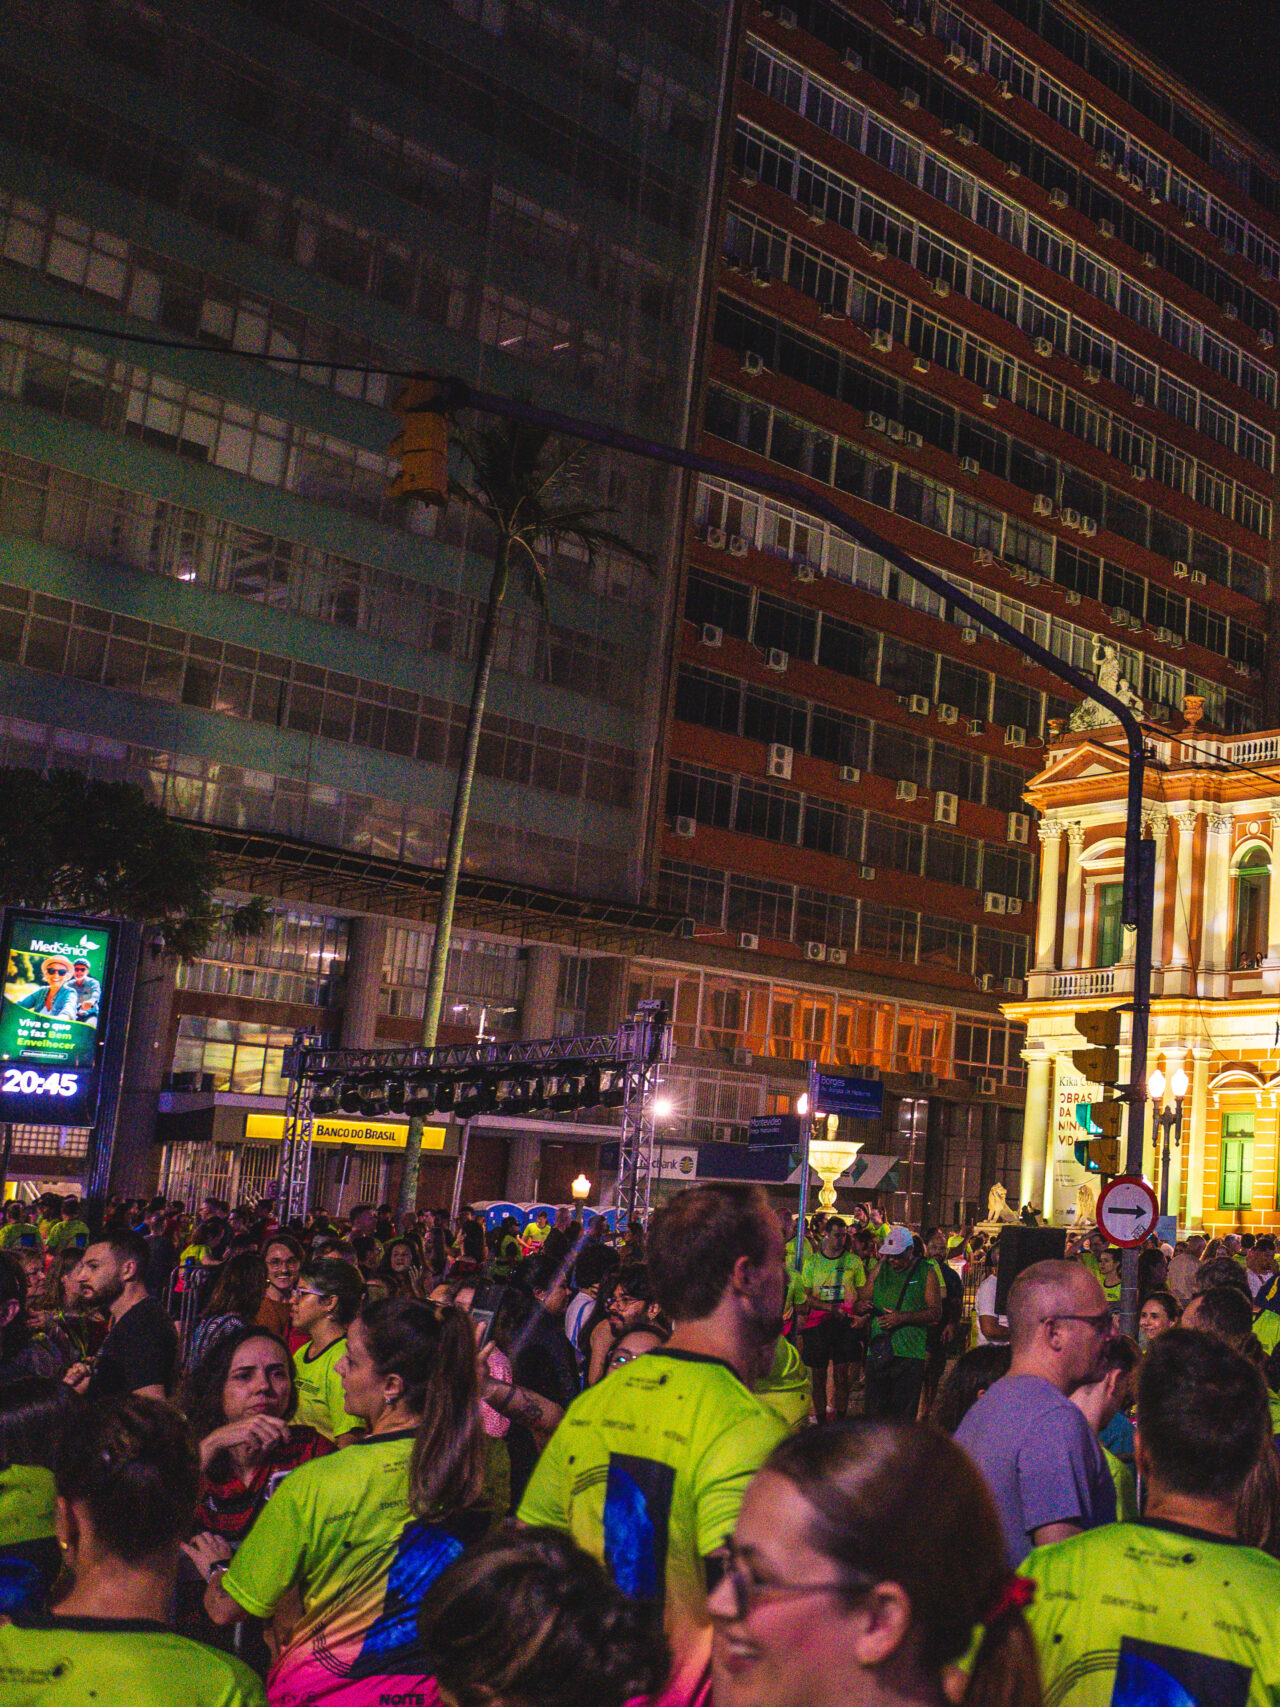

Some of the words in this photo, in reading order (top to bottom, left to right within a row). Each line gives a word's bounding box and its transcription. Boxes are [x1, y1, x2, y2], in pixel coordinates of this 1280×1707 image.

[30, 939, 89, 957] MedSênior
[19, 1018, 41, 1029] Viva
[42, 1021, 50, 1029] o
[51, 1021, 72, 1031] que
[17, 1028, 29, 1037] te
[30, 1028, 47, 1038] faz
[48, 1031, 72, 1040] Bem
[16, 1037, 75, 1050] Envelhecer
[2, 1069, 78, 1097] 20:45
[820, 1076, 845, 1088] Borges
[1059, 1076, 1078, 1087] Kika
[1059, 1093, 1092, 1104] OBRAS
[1059, 1106, 1072, 1118] DA
[316, 1124, 350, 1138] BANCO
[350, 1129, 364, 1139] DO
[364, 1128, 397, 1142] BRASIL
[379, 1693, 425, 1706] NOITE
